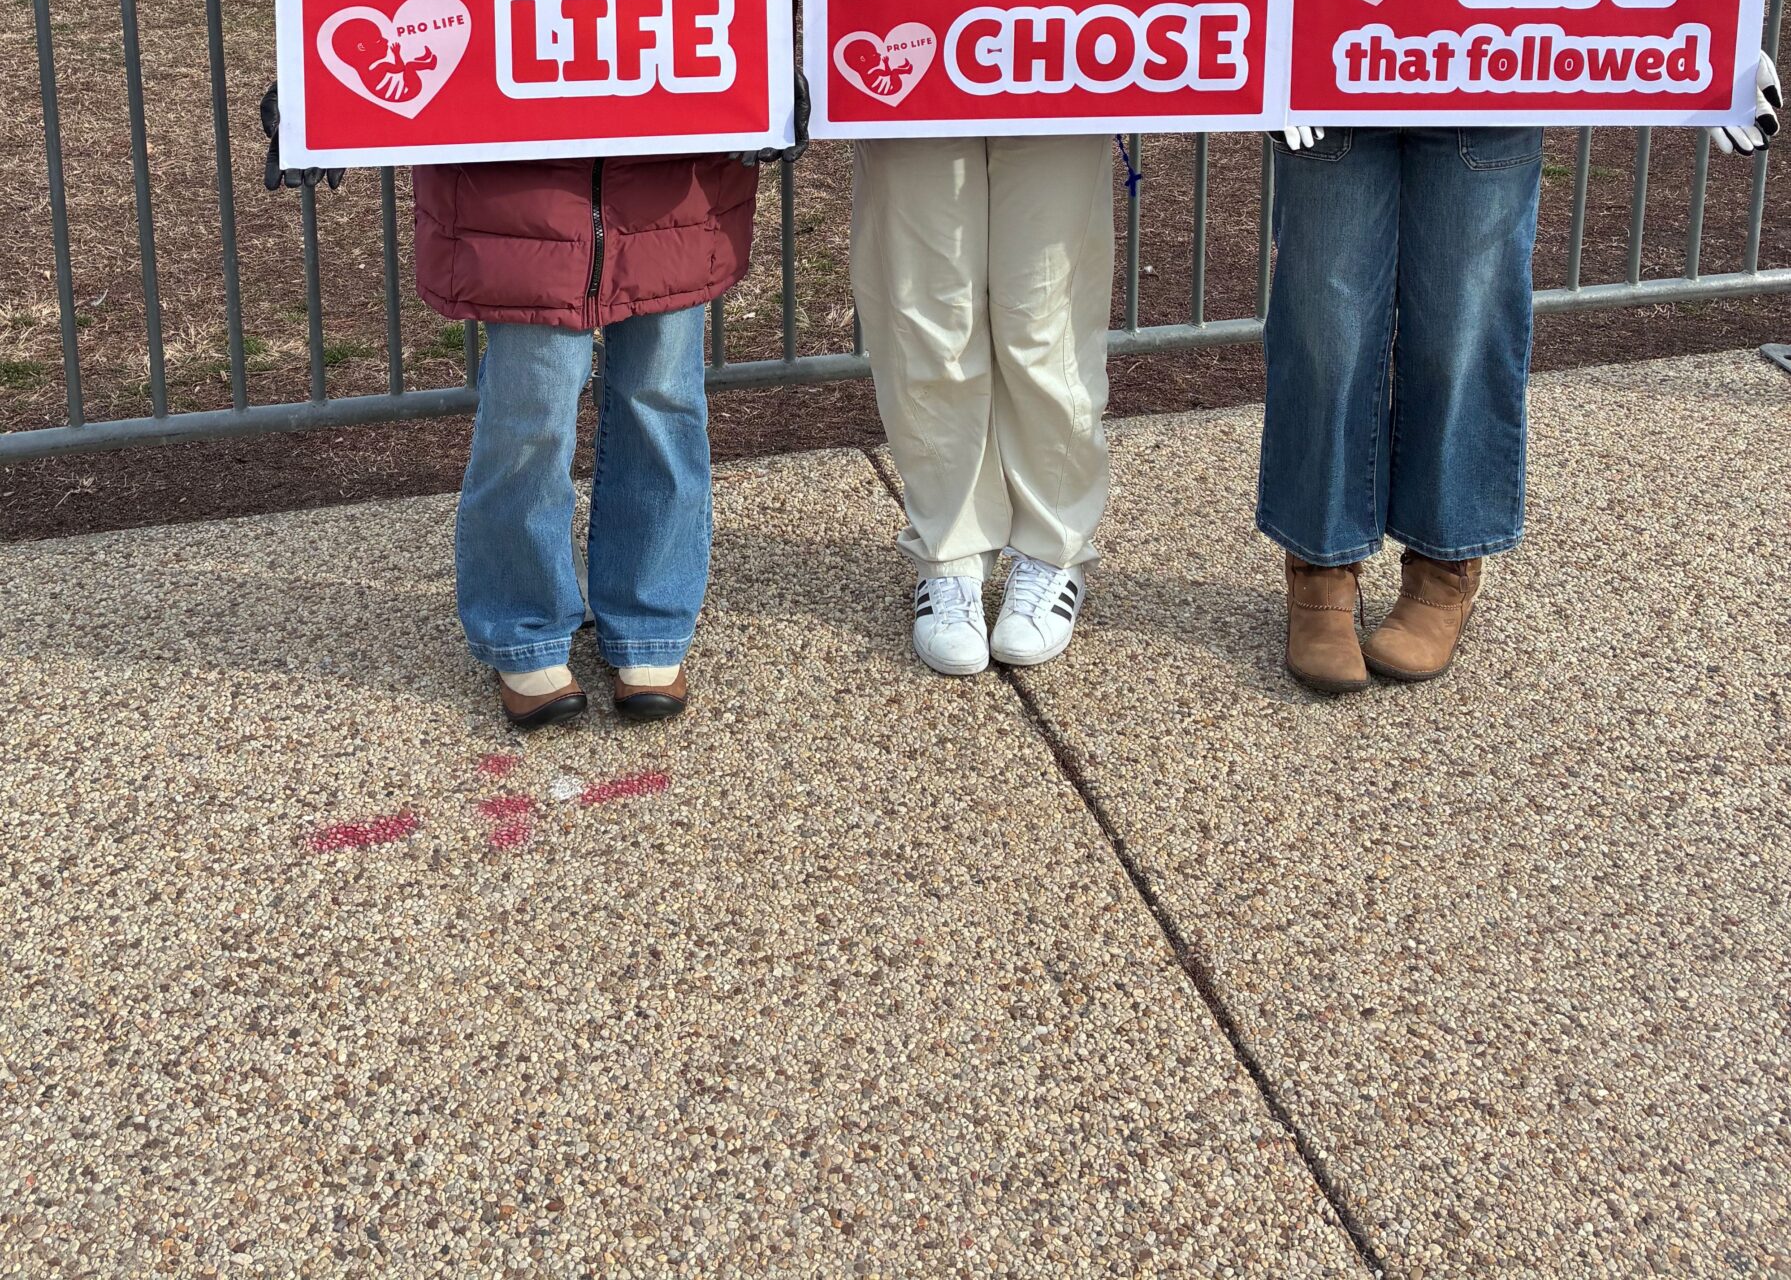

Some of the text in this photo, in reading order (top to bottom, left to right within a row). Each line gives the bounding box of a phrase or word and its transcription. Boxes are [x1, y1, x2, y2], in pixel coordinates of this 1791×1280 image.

[396, 14, 465, 38] PRO LIFE
[886, 37, 933, 53] PRO LIFE
[950, 9, 1244, 90] CHOSE
[1339, 29, 1706, 87] that followed
